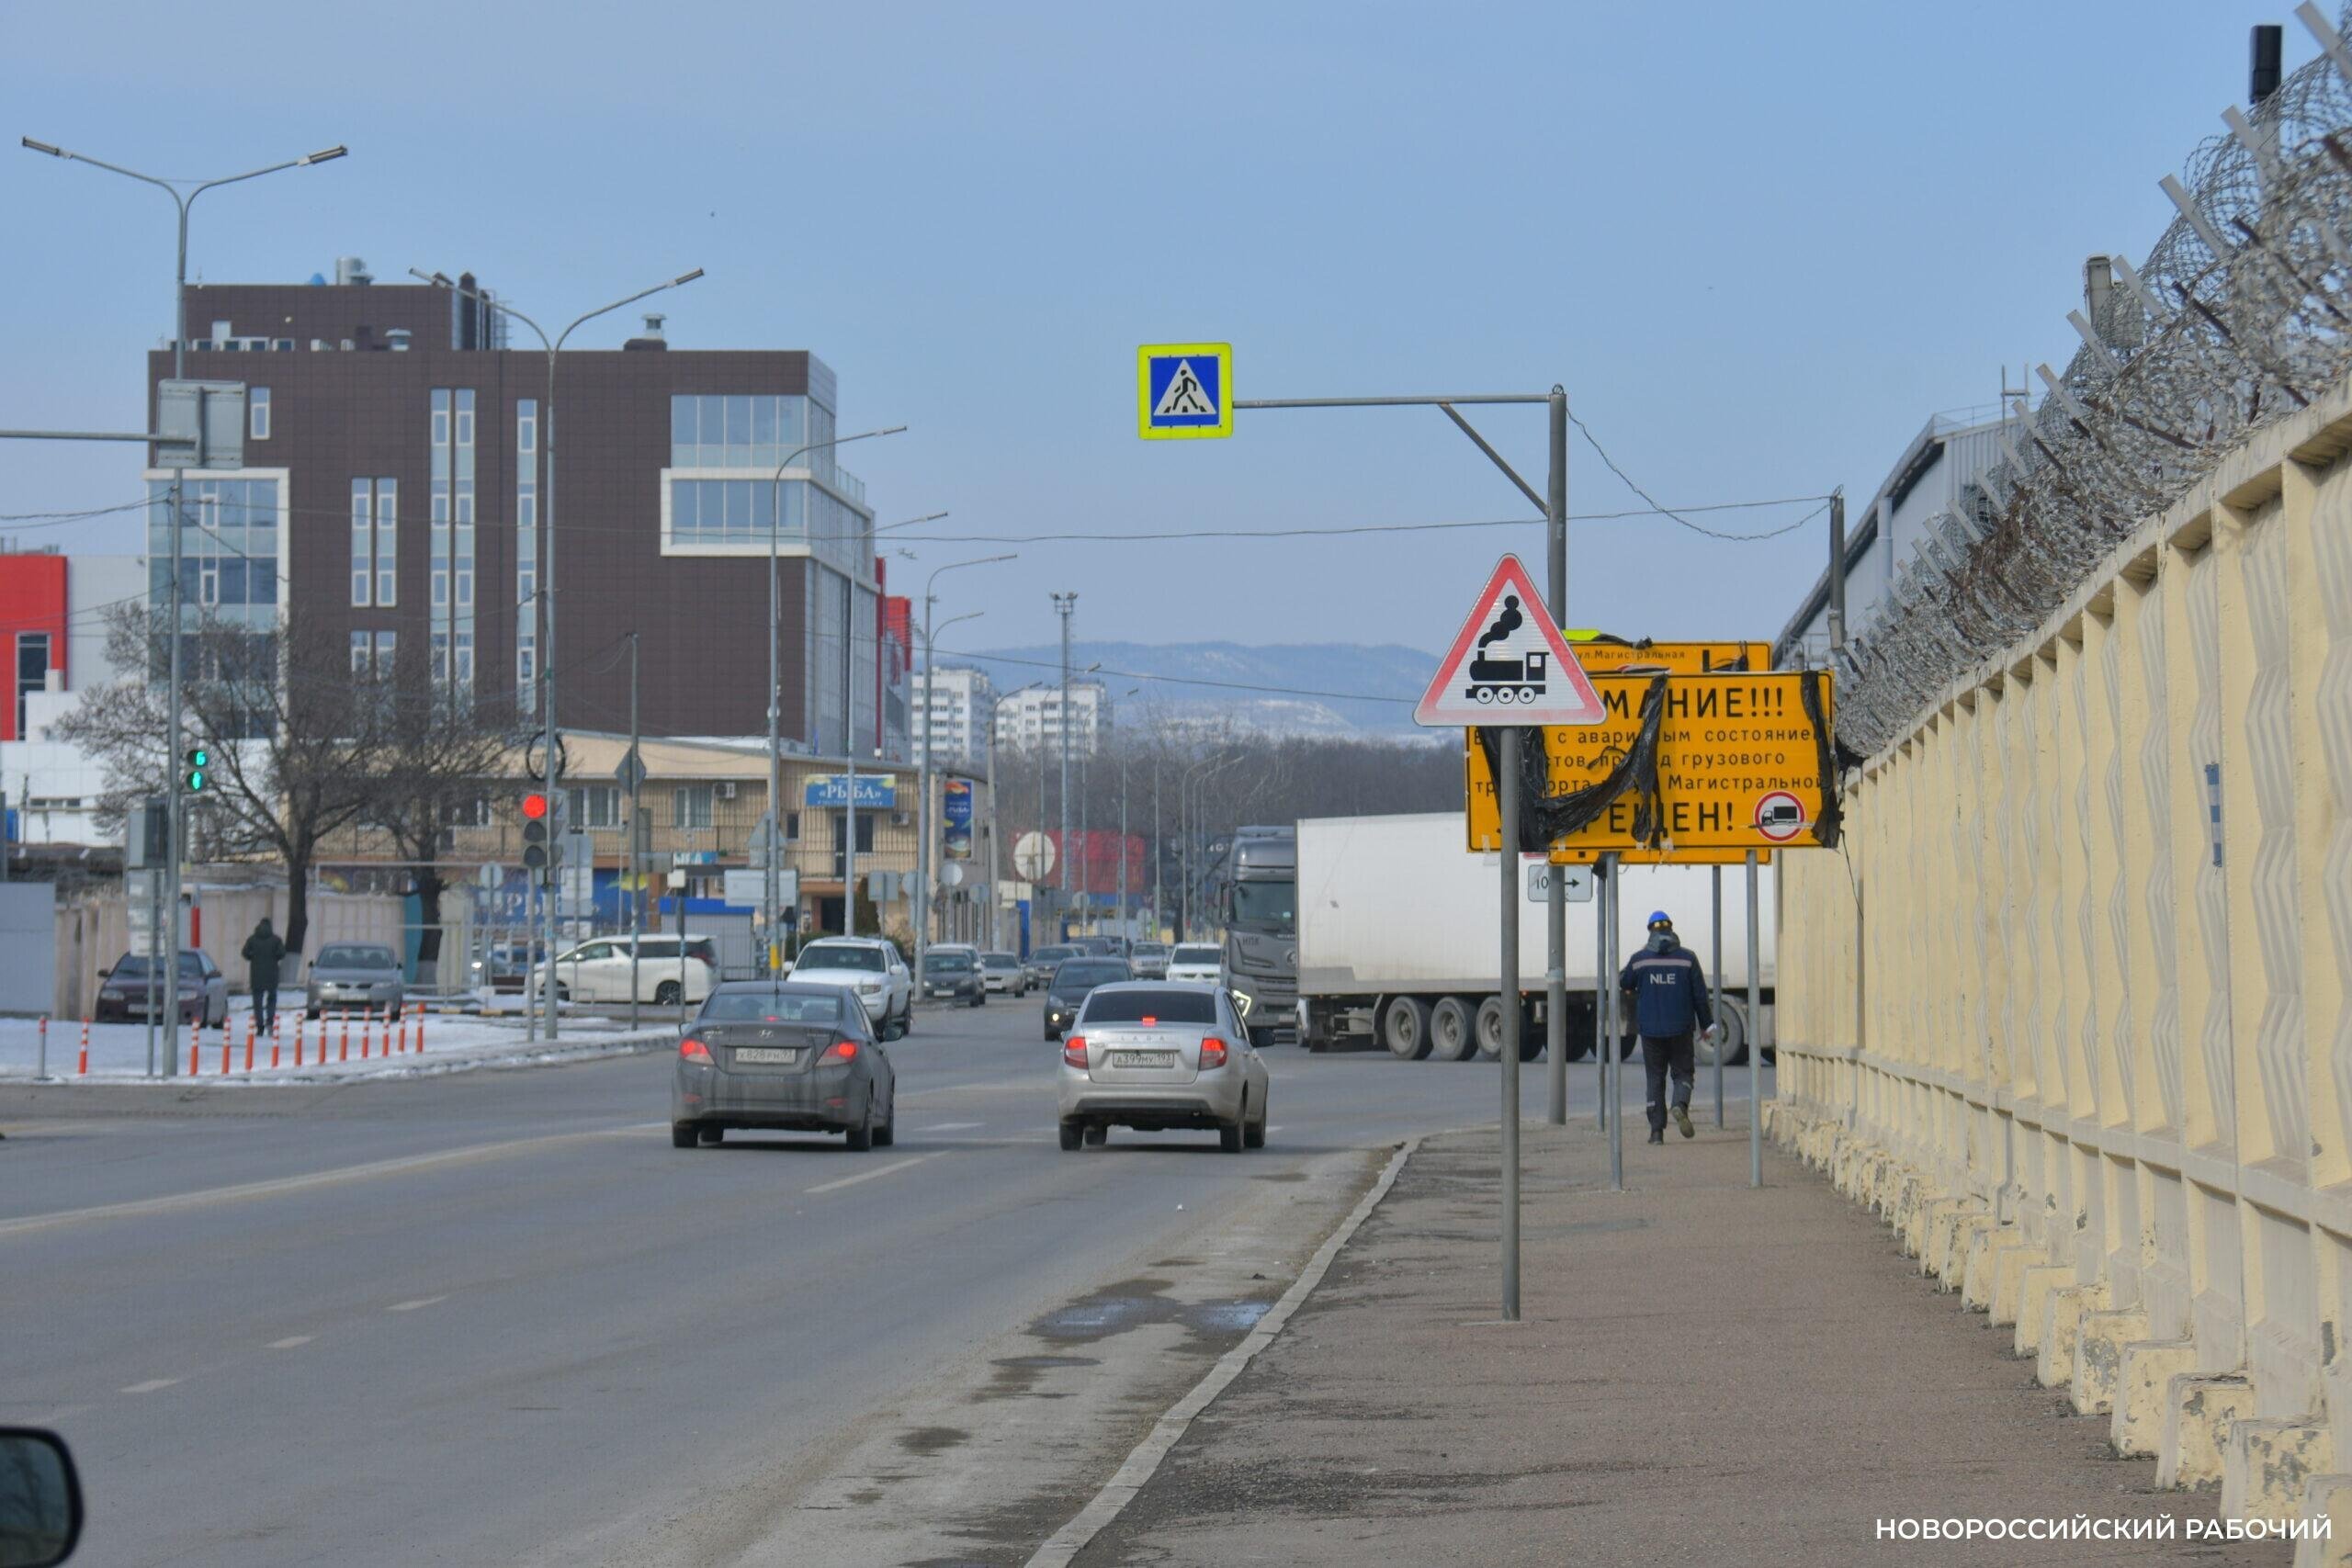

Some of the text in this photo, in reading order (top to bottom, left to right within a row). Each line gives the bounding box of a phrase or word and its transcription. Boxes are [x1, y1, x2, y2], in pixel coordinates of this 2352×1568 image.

[1603, 687, 1783, 718] МНИЕ!!!
[1577, 729, 1690, 748] авариым
[1682, 752, 1785, 769] грузового
[1649, 973, 1676, 985] NLE
